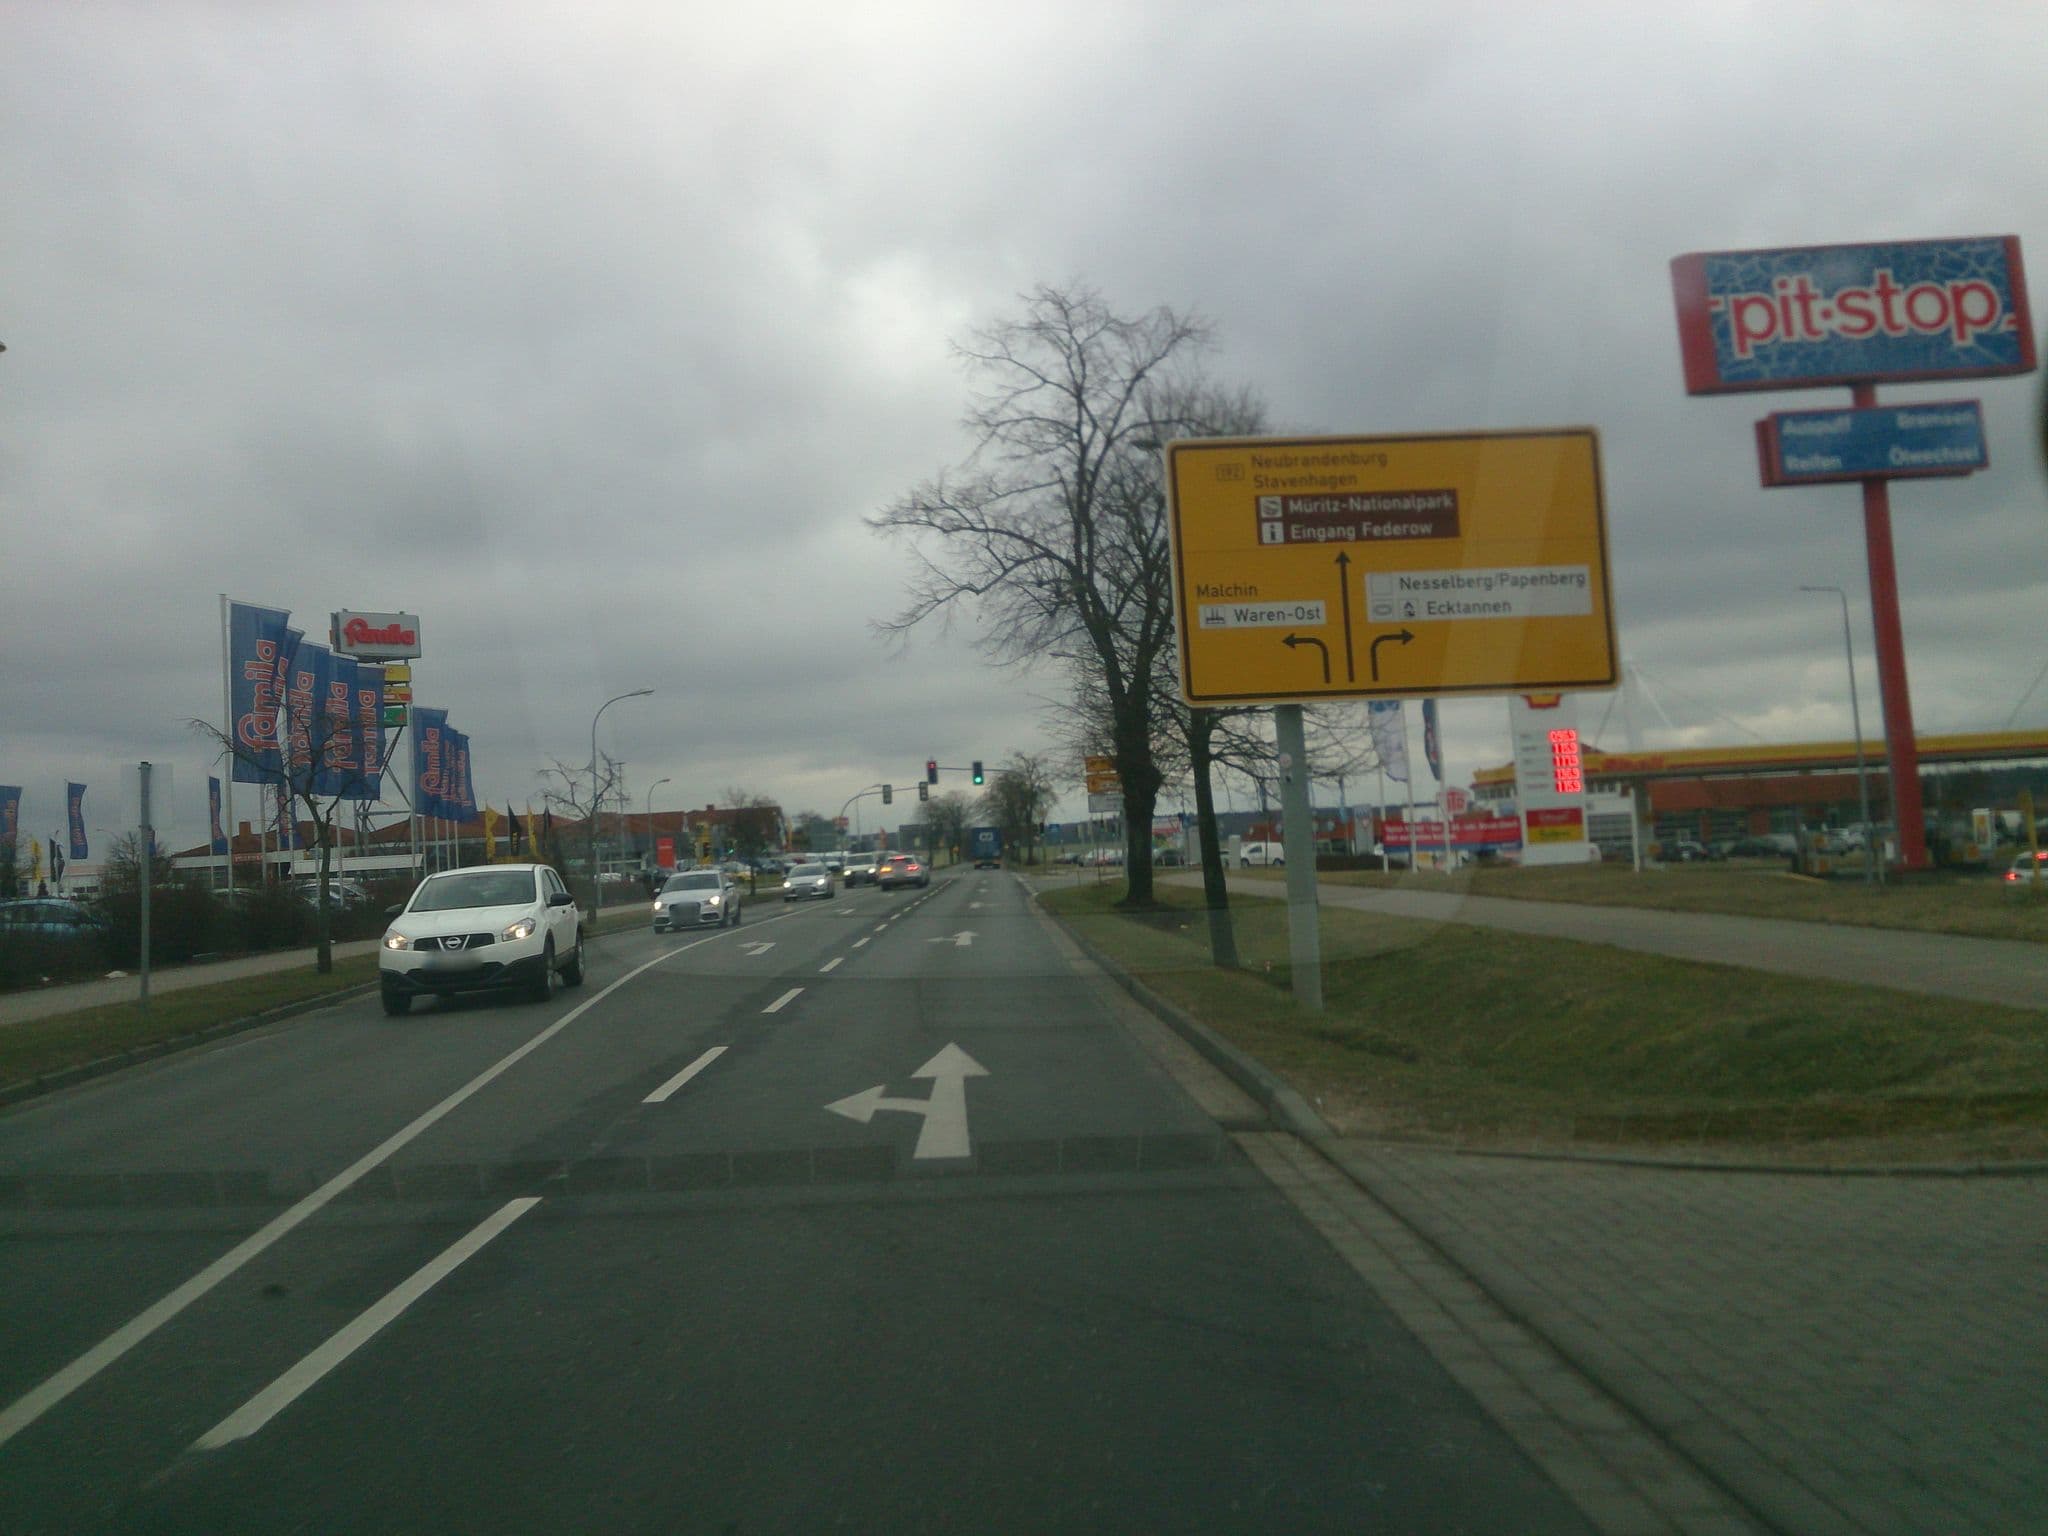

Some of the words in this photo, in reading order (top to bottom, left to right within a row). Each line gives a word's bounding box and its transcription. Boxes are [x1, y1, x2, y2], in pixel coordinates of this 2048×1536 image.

[1251, 452, 1388, 469] Neubrandenburg
[1254, 473, 1358, 490] Stavenhagen
[1288, 493, 1453, 514] Müritz-Nationalpark
[1290, 524, 1356, 541] Eingang
[1362, 521, 1433, 537] Federow
[1400, 572, 1586, 592] Nesselberg/Papenberg
[1196, 584, 1258, 598] Malchin
[1233, 606, 1321, 622] Waren-Ost
[1427, 601, 1512, 616] Ecktannen
[238, 639, 281, 752] famila
